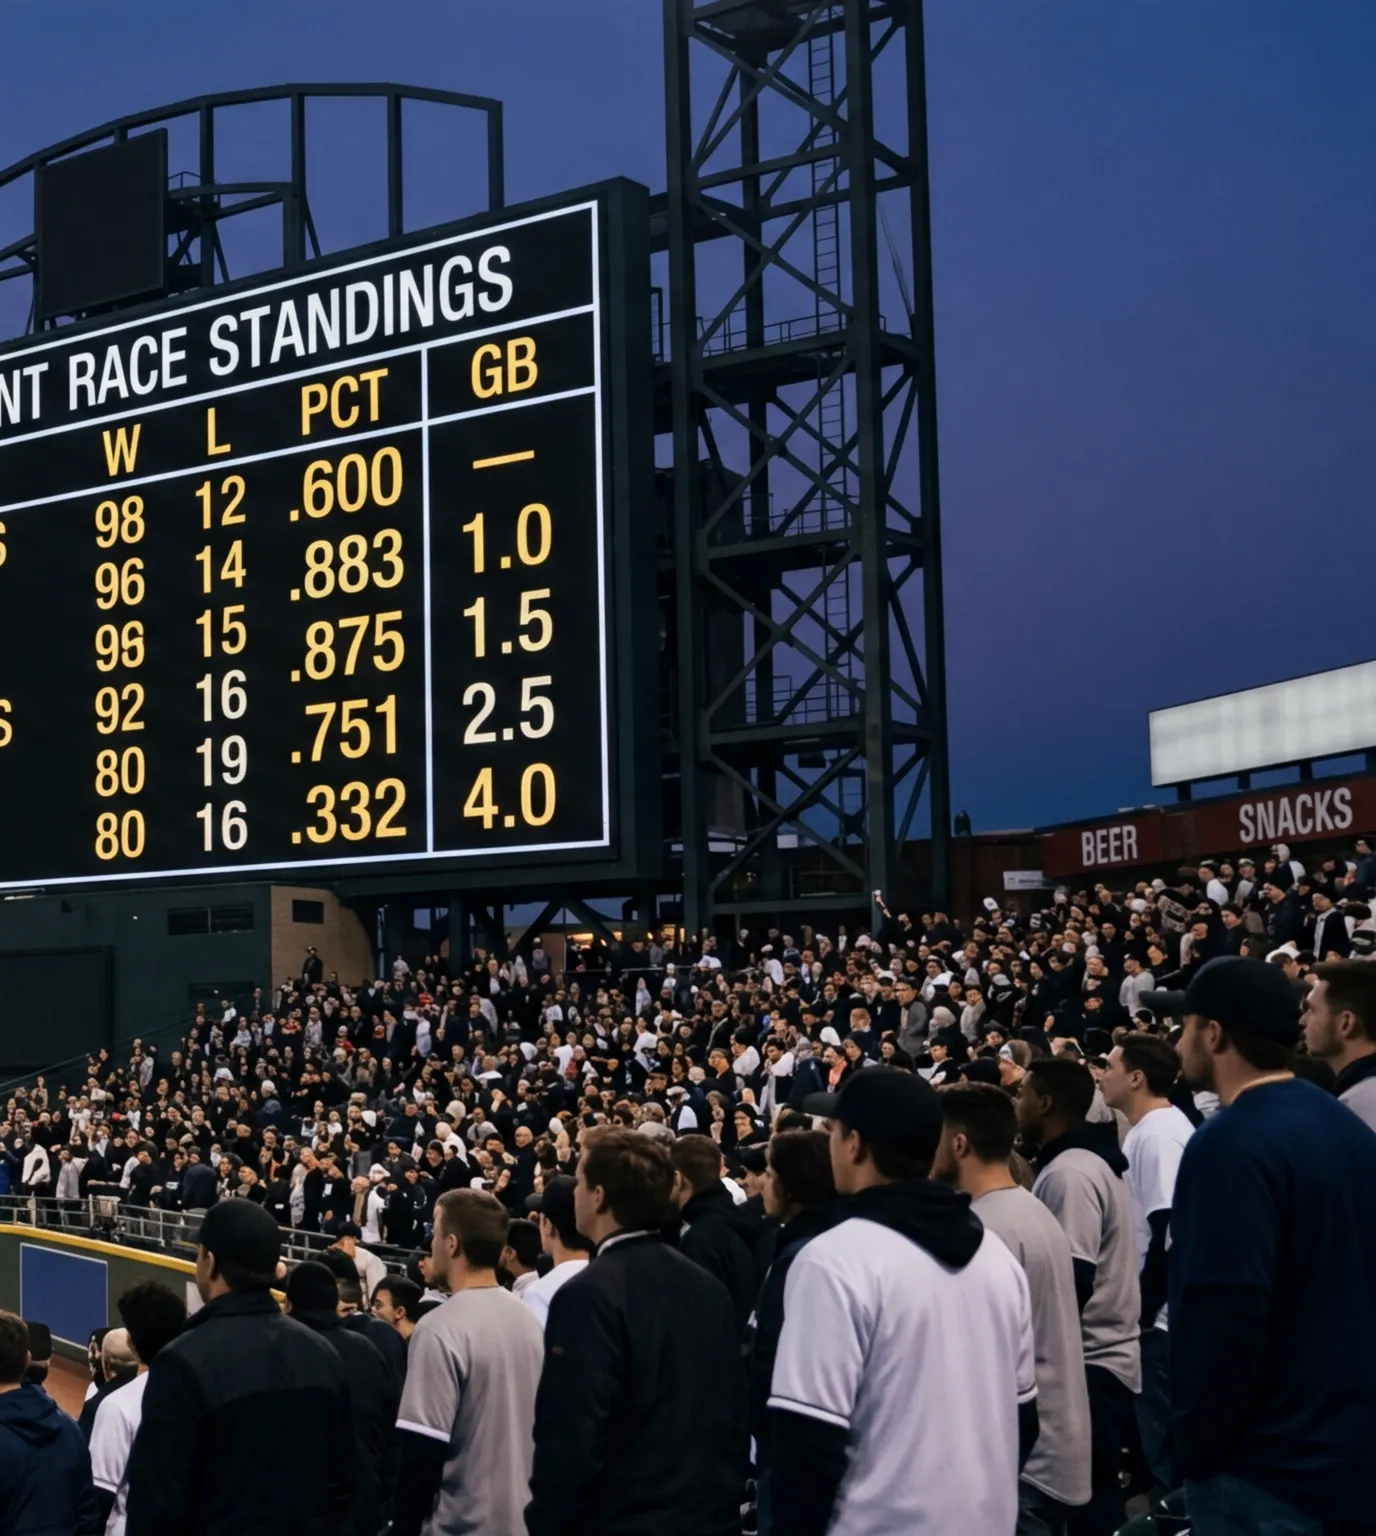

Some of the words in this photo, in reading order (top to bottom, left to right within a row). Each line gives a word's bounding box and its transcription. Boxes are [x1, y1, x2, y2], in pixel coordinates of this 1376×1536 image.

[69, 327, 187, 410] RACE
[210, 246, 513, 376] STANDINGS
[103, 424, 141, 476] W
[208, 408, 231, 455] L
[302, 368, 388, 435] PCT
[472, 337, 537, 398] GB
[95, 496, 144, 548] 98
[196, 475, 245, 529] 12
[290, 447, 402, 521] .600
[95, 558, 144, 609] 96
[196, 540, 246, 593] 14
[291, 529, 404, 601] .883
[463, 503, 551, 573] 1.0
[196, 605, 246, 657] 15
[291, 611, 404, 682] .875
[464, 588, 552, 657] 1.5
[95, 683, 144, 734] 92
[196, 670, 247, 721] 16
[292, 695, 396, 763] .751
[463, 675, 554, 744] 2.5
[95, 747, 145, 797] 80
[196, 735, 247, 786] 19
[292, 778, 406, 844] .332
[464, 763, 556, 829] 4.0
[95, 810, 145, 860] 80
[197, 800, 247, 851] 16
[1240, 788, 1352, 842] SNACKS
[1082, 825, 1137, 865] BEER
